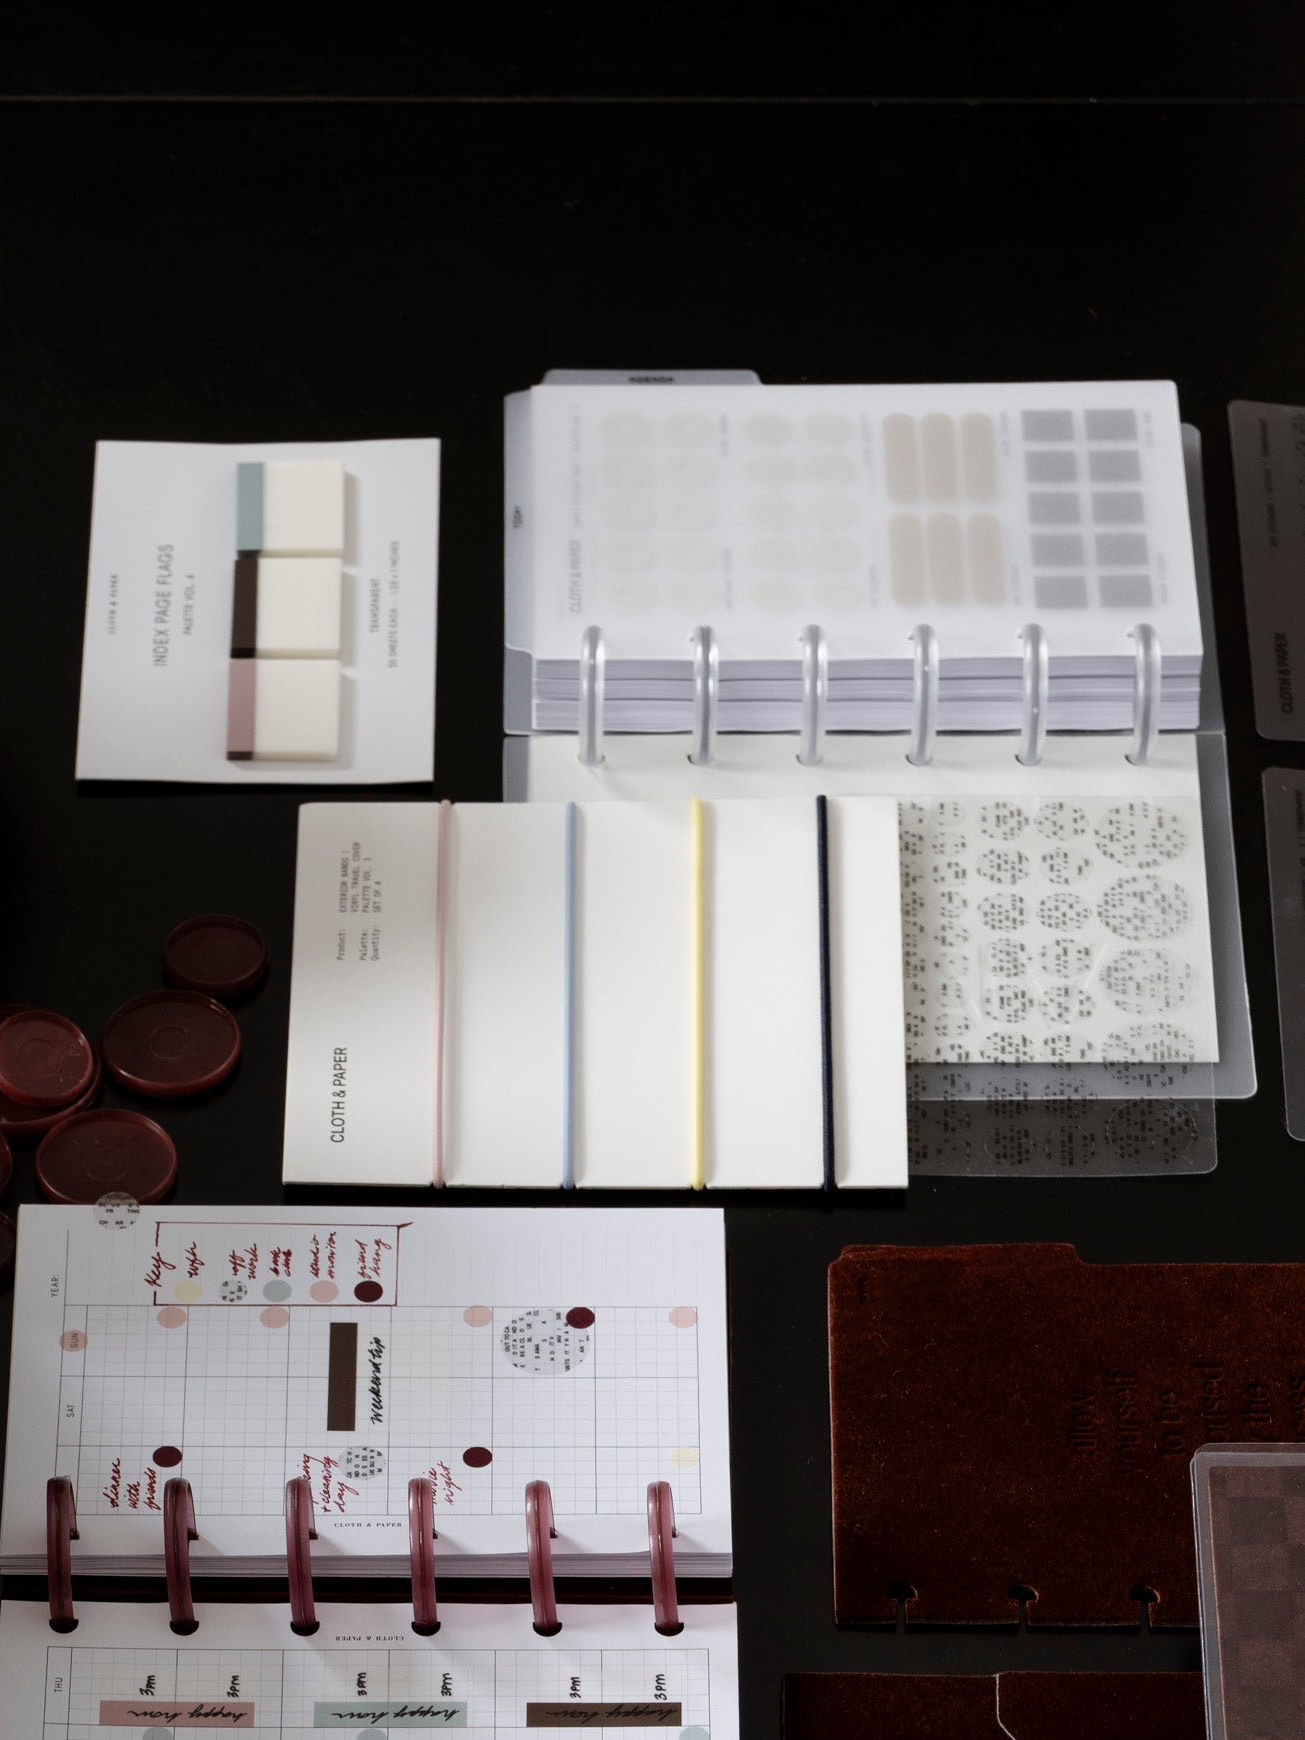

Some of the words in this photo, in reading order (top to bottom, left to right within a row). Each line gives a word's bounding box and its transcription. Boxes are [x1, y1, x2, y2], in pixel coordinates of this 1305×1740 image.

[155, 543, 175, 586] FLAGS
[154, 590, 172, 624] PAGE
[184, 583, 196, 601] VOL.
[368, 578, 381, 634] TRANSPARENT
[182, 604, 195, 636] PALETTE
[151, 628, 170, 667] INDEX
[340, 856, 350, 878] BANDS
[352, 841, 362, 862] COVER
[351, 865, 361, 890] TRAVEL
[373, 889, 383, 897] OF
[338, 880, 349, 913] EXTERIOR
[351, 892, 361, 913] VINYL
[361, 885, 372, 913] PALETTE
[372, 900, 383, 913] SET
[336, 928, 347, 961] Product:
[359, 929, 370, 961] Palette:
[370, 925, 382, 961] Quantity:
[332, 1047, 348, 1087] PAPER
[332, 1089, 347, 1098] &
[330, 1101, 347, 1144] CLOTH
[242, 1243, 259, 1281] work
[50, 1274, 60, 1298] YEAR:
[70, 1331, 81, 1351] SUN
[66, 1403, 76, 1418] SAT
[101, 1457, 121, 1508] dinner
[123, 1480, 141, 1510] with
[332, 1480, 359, 1513] day
[438, 1460, 463, 1506] night
[53, 1677, 63, 1693] THU
